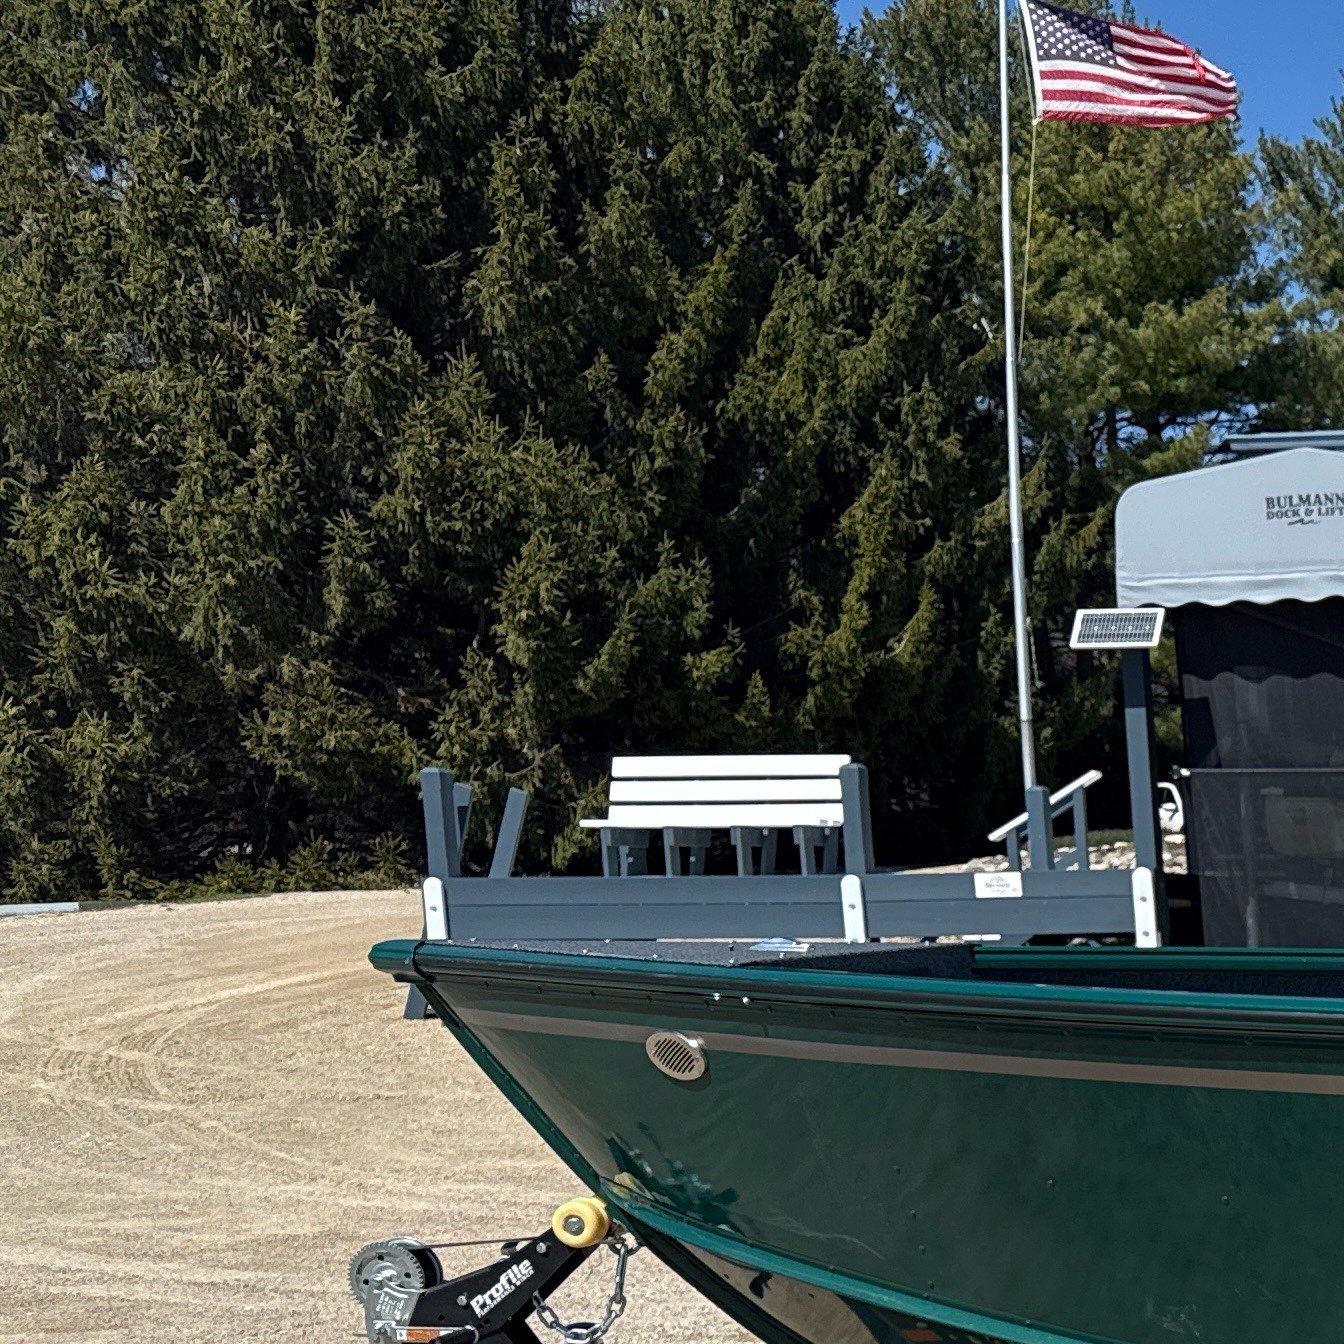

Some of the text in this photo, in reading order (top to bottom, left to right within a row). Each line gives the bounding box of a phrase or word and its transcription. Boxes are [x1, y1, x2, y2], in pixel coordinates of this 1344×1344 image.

[1266, 509, 1301, 520] DOCK
[1305, 507, 1315, 517] &
[470, 1259, 533, 1314] Profile
